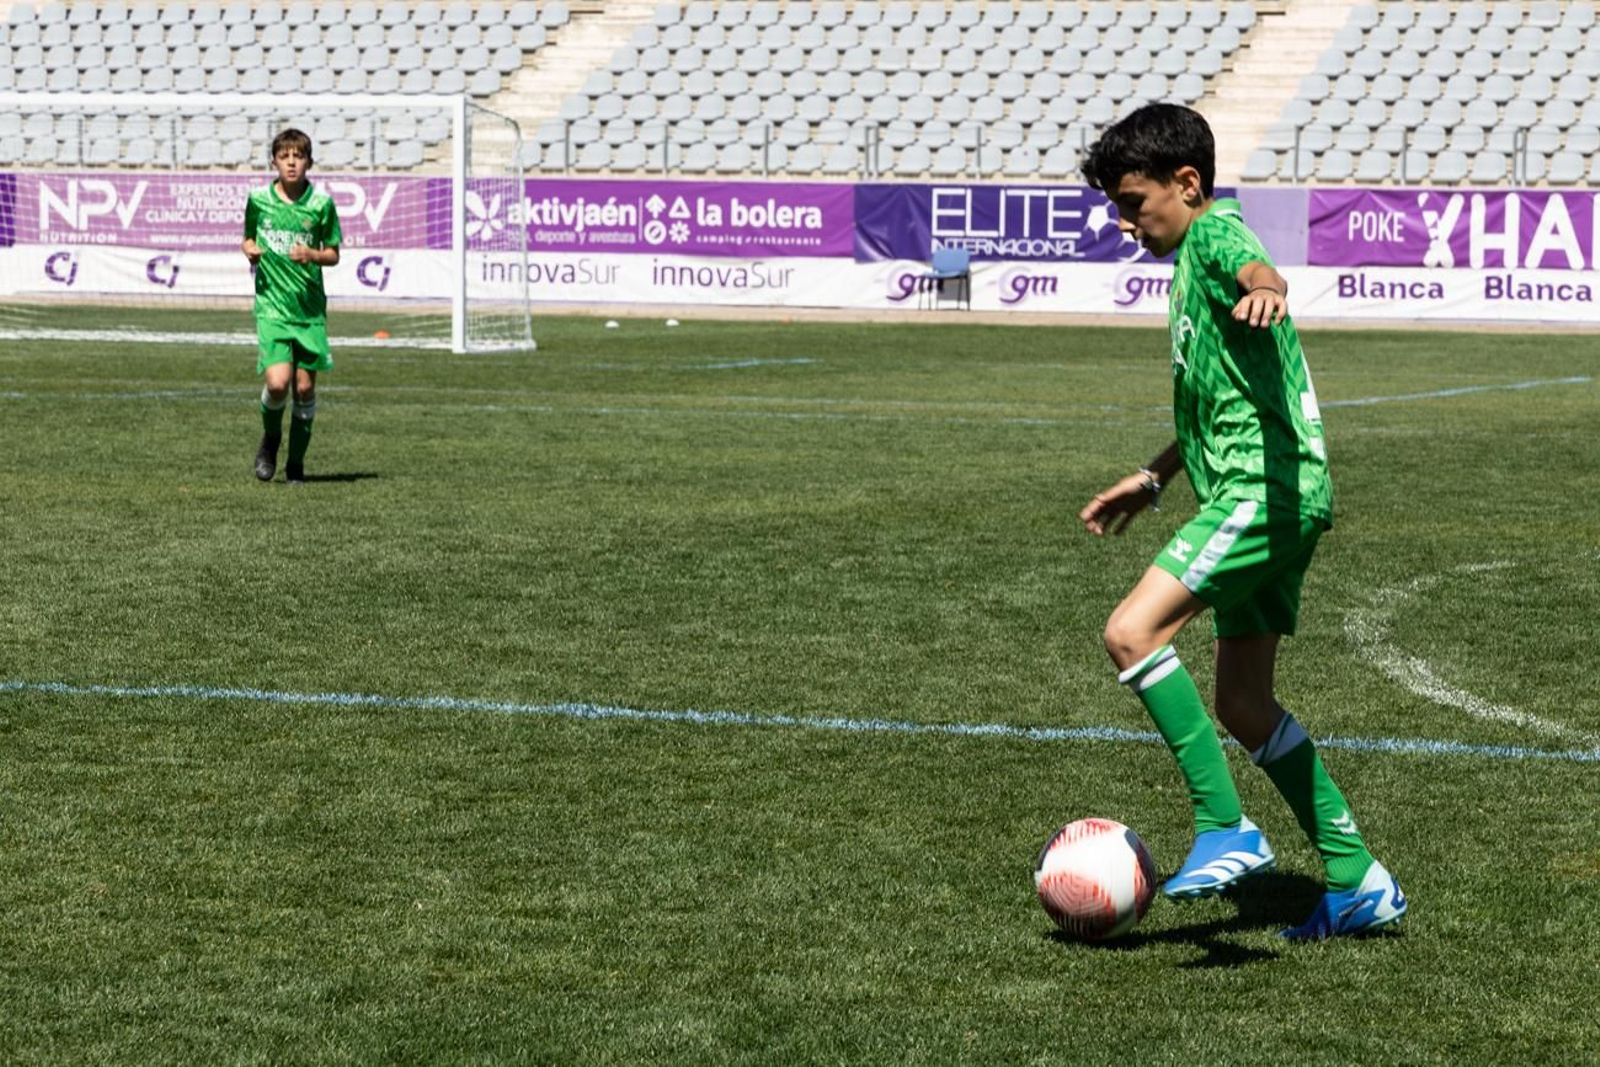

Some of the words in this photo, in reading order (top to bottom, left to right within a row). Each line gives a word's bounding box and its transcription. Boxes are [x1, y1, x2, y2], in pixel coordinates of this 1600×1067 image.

[39, 178, 149, 230] NPV
[208, 210, 246, 223] DEPO
[316, 181, 399, 232] PV
[507, 196, 637, 232] aktivjaén
[696, 196, 723, 227] la
[730, 197, 823, 229] bolera
[931, 188, 1083, 239] ELITE
[39, 233, 118, 244] NUTRITION
[1348, 210, 1406, 243] POKE
[931, 237, 1085, 257] INTERNACIONAL
[482, 255, 620, 284] innovaSur
[653, 257, 795, 289] innovaSur
[1337, 273, 1445, 300] Blanca
[1484, 274, 1593, 302] Blanca
